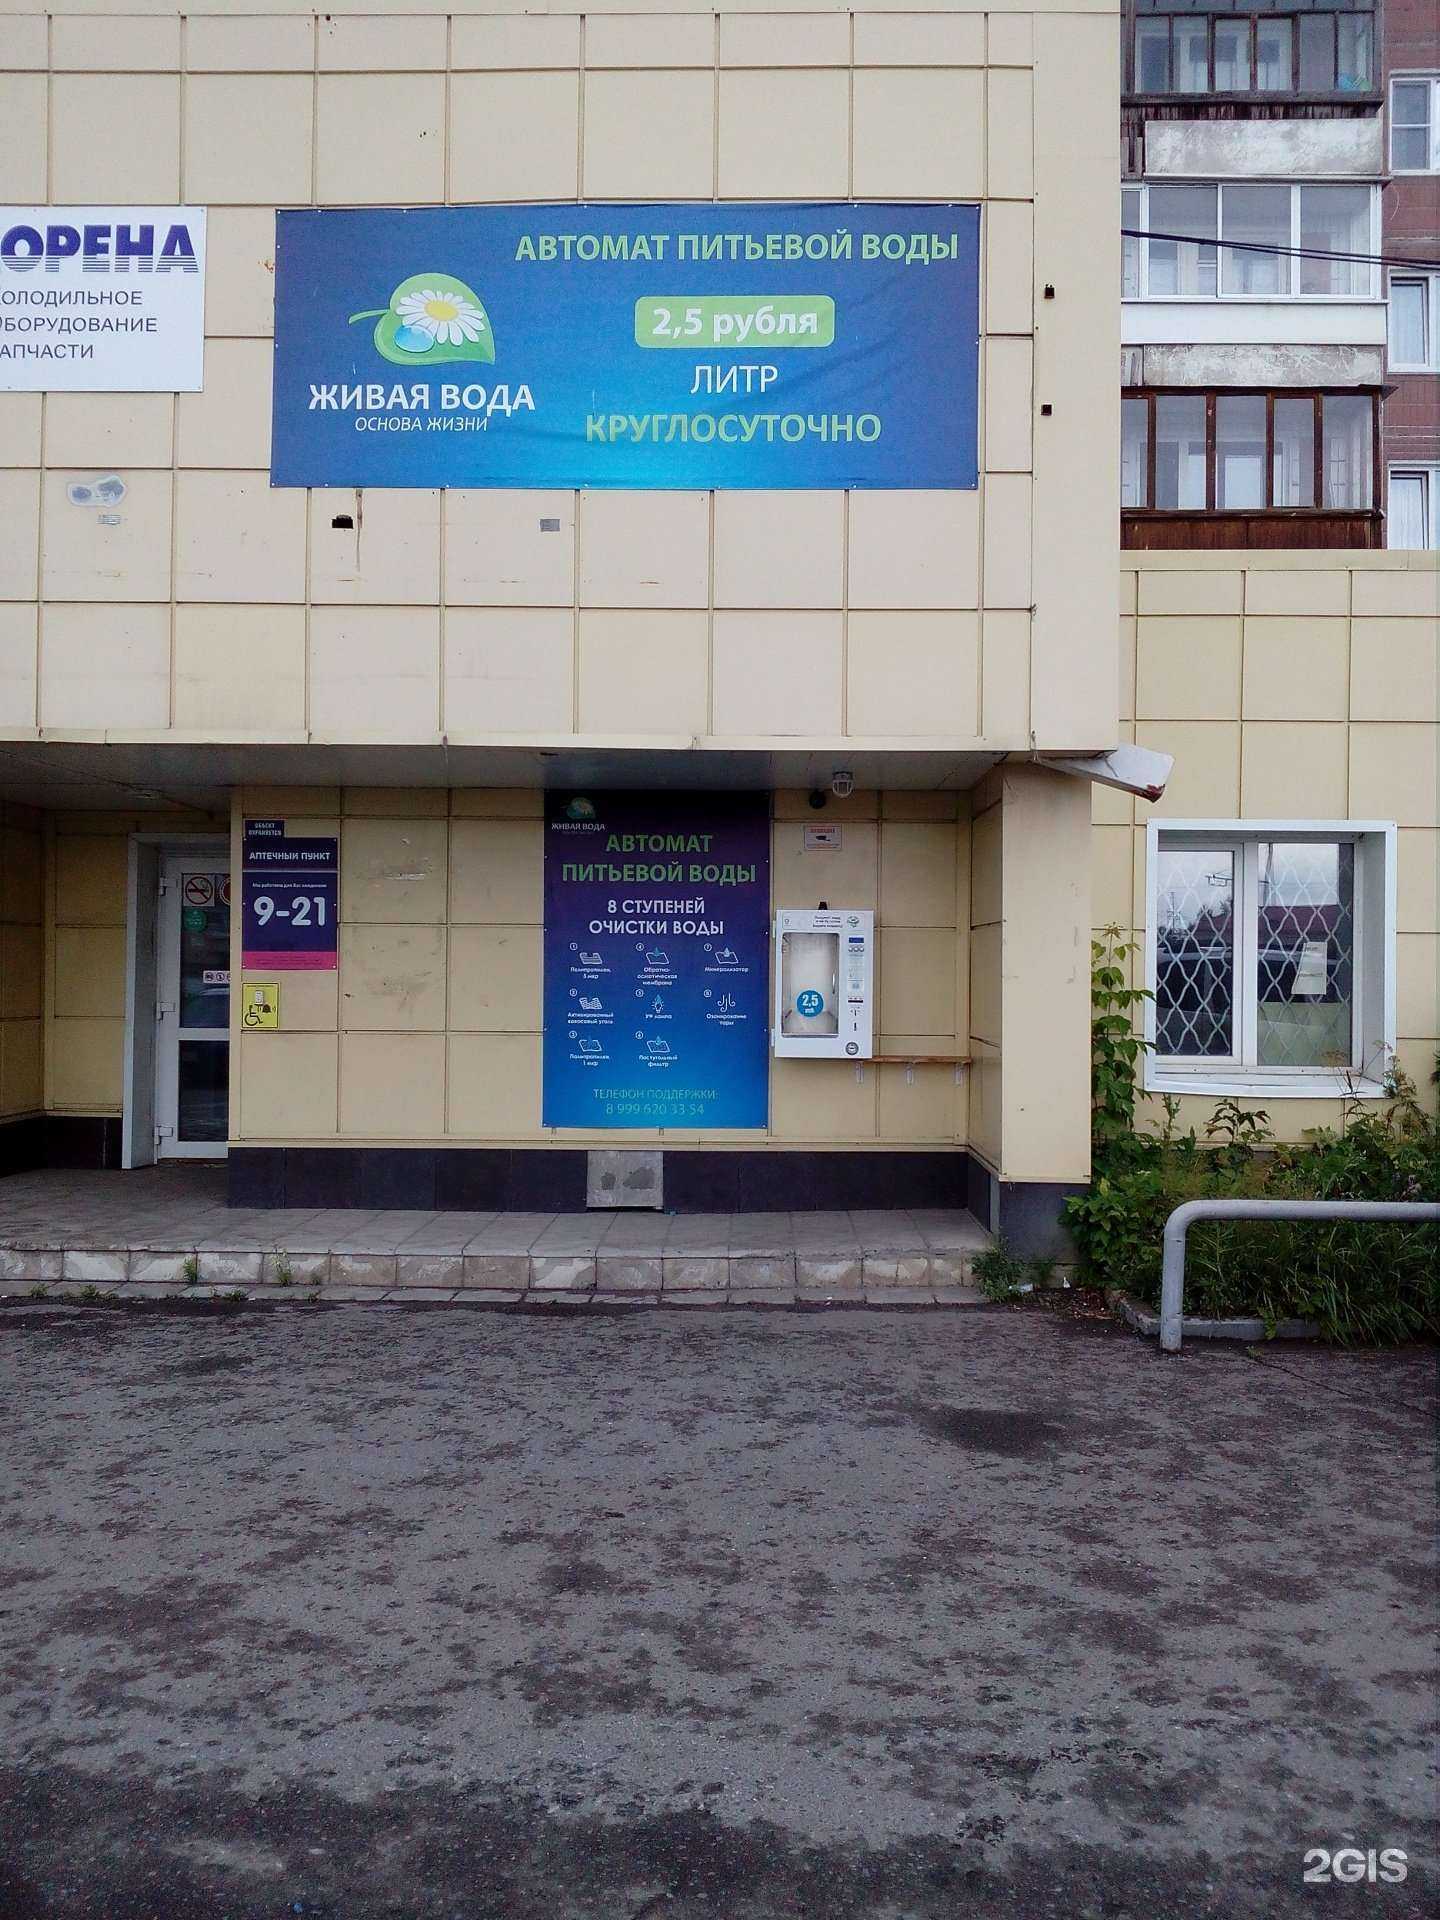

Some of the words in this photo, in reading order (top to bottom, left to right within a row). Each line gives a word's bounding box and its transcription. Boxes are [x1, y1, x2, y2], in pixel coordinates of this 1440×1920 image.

[514, 234, 670, 261] АВТОМАТ
[678, 229, 852, 261] ПИТЬЕВОЙ
[861, 233, 959, 265] ВОДЫ
[0, 290, 143, 308] ОЛОДИЛЬНОЕ
[652, 307, 702, 340] 2,5
[713, 306, 818, 342] рубля
[690, 365, 778, 394] ЛИТР
[308, 384, 430, 410] ЖИВАЯ
[441, 384, 536, 417] ВОДА
[355, 416, 422, 431] ОСНОВА
[426, 416, 488, 432] ЖИЗНИ
[585, 413, 882, 443] КРУГЛОСУТОЧНО
[551, 822, 581, 831] ЖИВАЯ
[582, 822, 606, 832] ВОДА
[606, 834, 713, 852] АВТОМАТ
[301, 851, 331, 861] ПУНКТ
[562, 860, 683, 882] ПИТЬЕВОЙ
[689, 863, 756, 886] ВОДЫ
[253, 895, 326, 926] 9-21
[607, 899, 618, 914] 8
[622, 897, 705, 914] СТУПЕНЕЙ
[589, 920, 668, 935] ОЧИСТКИ
[673, 920, 724, 936] ВОДЫ
[802, 994, 819, 1008] 2,5
[593, 1088, 645, 1100] ТЕЛЕФОН
[606, 1103, 614, 1114] 8
[617, 1103, 641, 1114] 999
